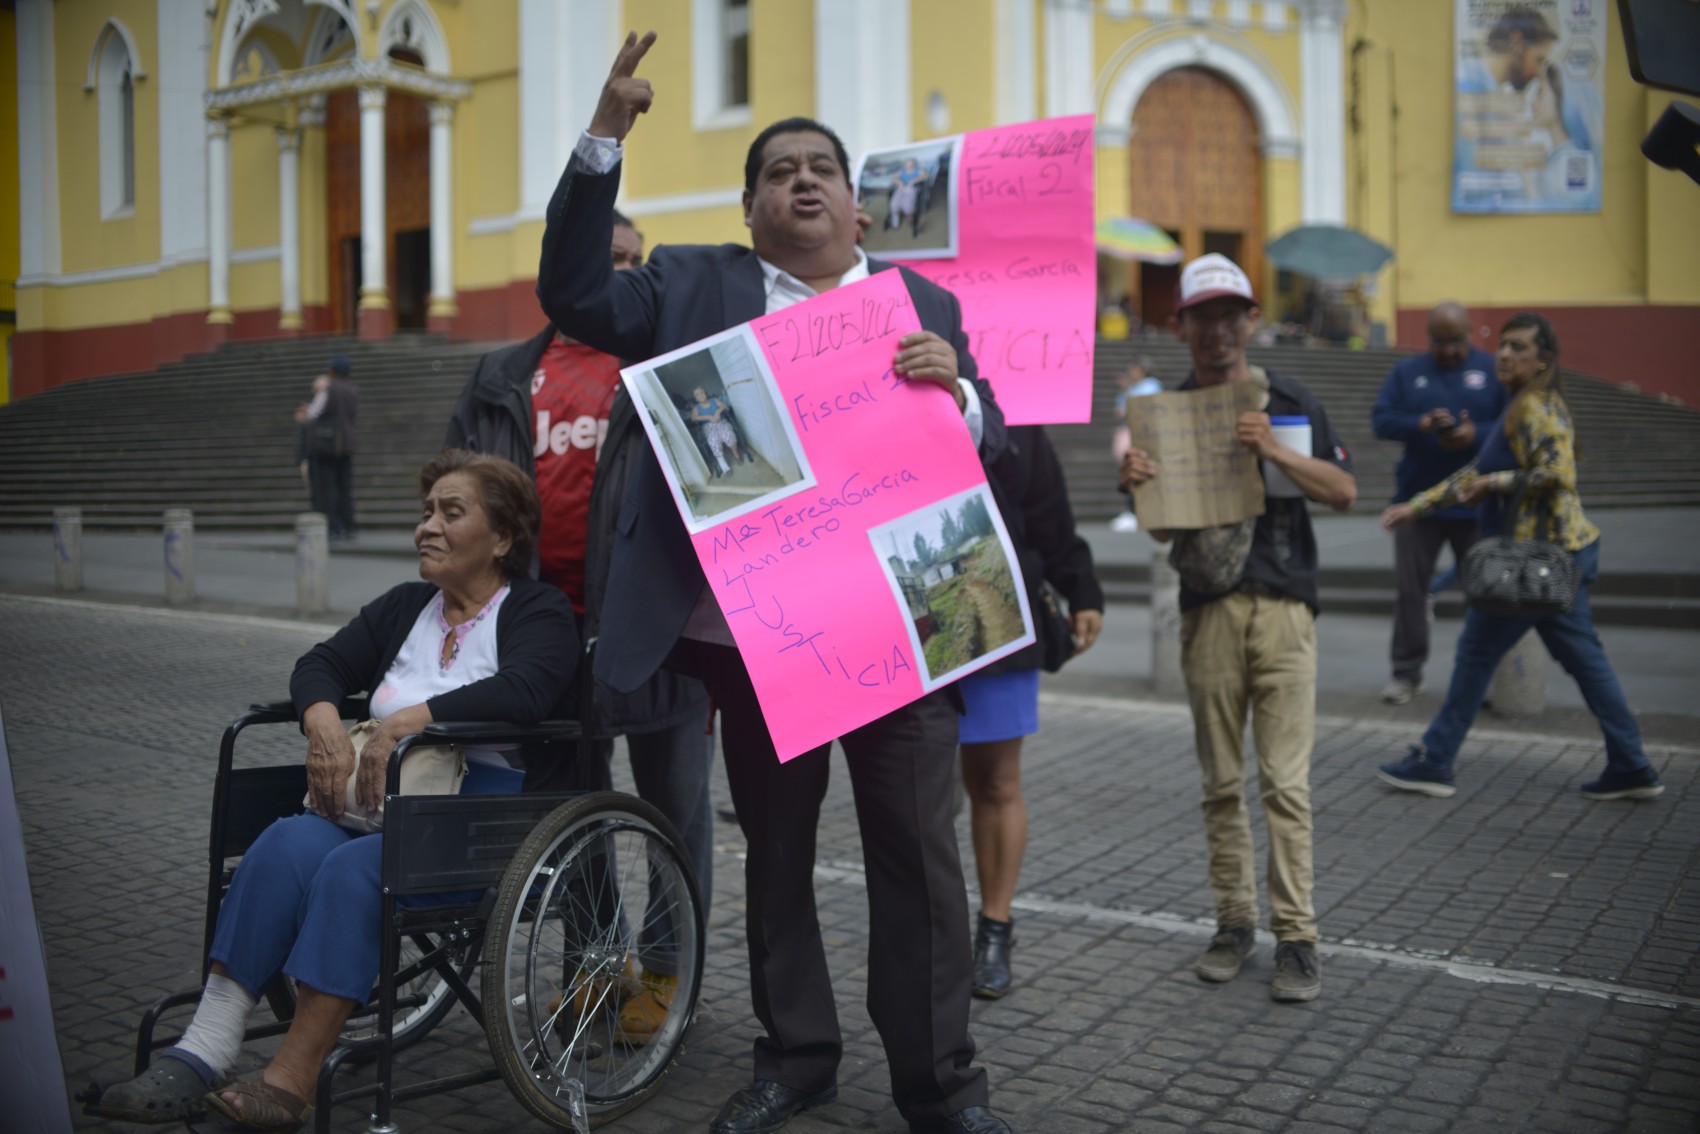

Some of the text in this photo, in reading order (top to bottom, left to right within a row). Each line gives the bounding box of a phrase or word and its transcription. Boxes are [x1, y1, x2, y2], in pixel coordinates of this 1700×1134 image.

[1037, 162, 1075, 196] 2
[794, 380, 877, 432] Fiscal
[723, 518, 840, 586] Landero
